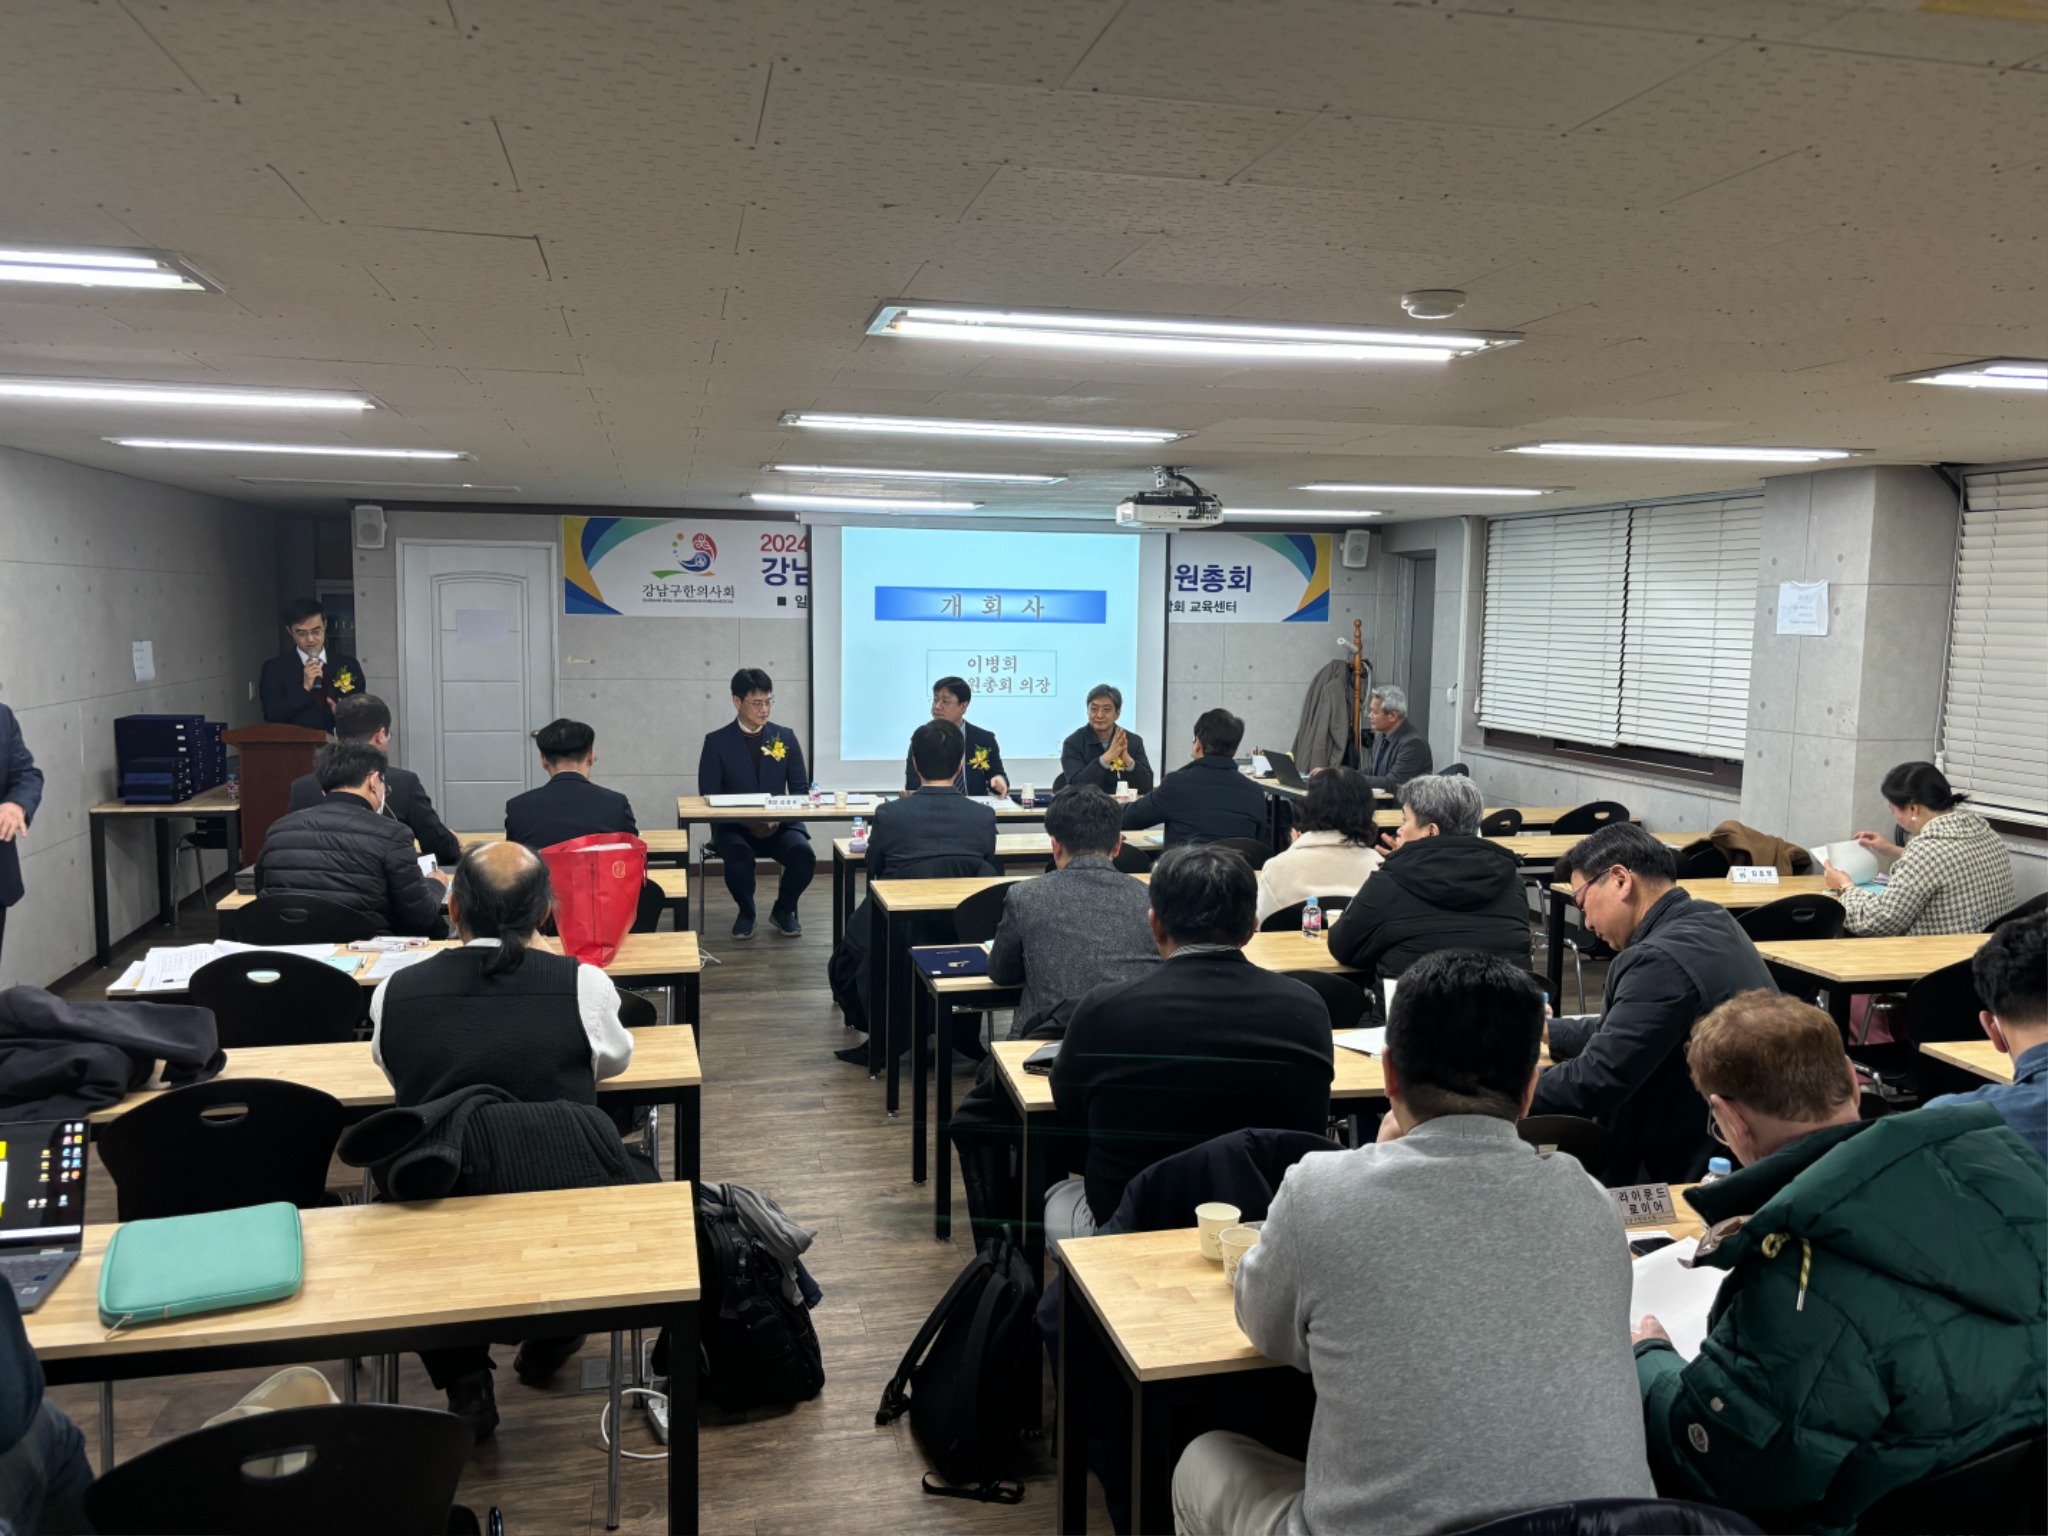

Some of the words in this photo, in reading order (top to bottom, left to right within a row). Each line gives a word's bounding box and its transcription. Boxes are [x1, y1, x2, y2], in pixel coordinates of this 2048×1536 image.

[1169, 564, 1252, 593] 원총회
[642, 583, 735, 598] 강남구한의사회
[1189, 600, 1237, 613] 교육센터
[967, 654, 1017, 674] 이병희
[1019, 676, 1051, 694] 의장
